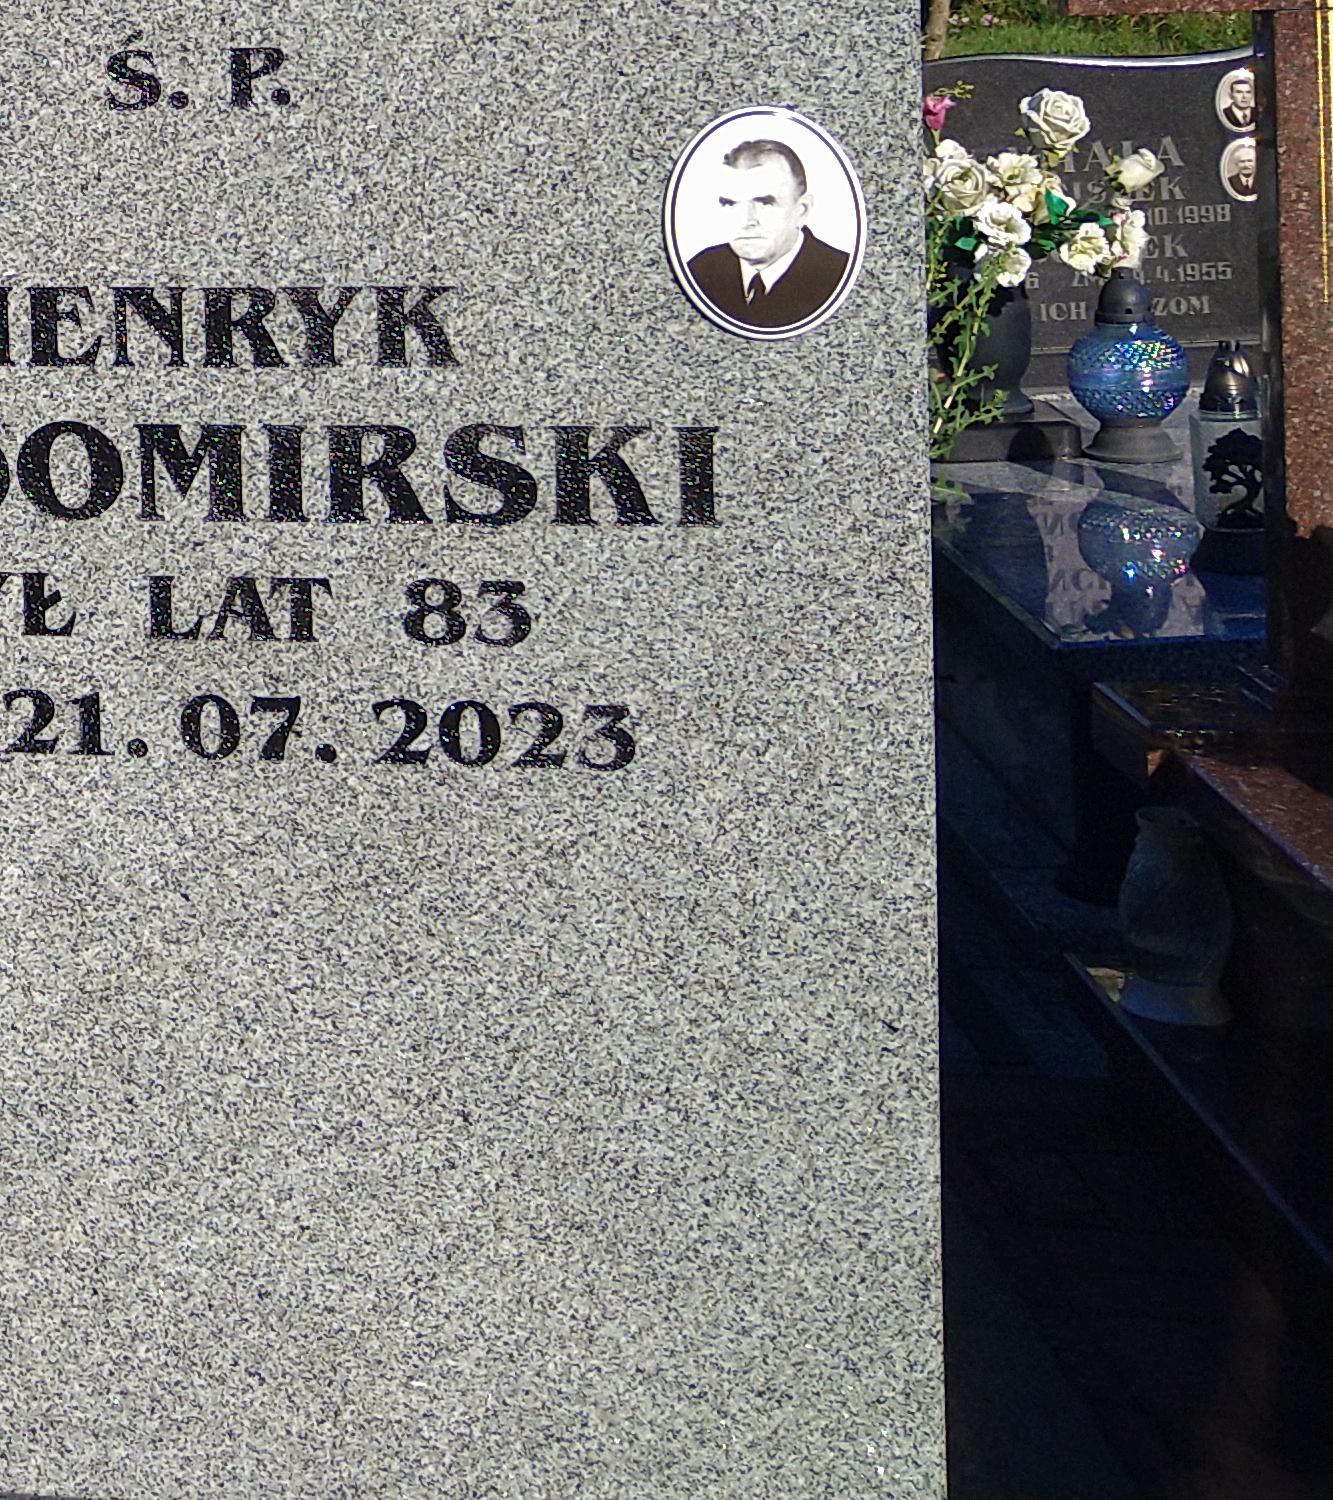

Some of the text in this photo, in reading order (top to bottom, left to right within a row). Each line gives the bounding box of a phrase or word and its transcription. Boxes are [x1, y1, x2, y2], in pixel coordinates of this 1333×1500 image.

[1039, 301, 1088, 322] ICH
[146, 575, 332, 642] LAT
[402, 578, 532, 646] 83
